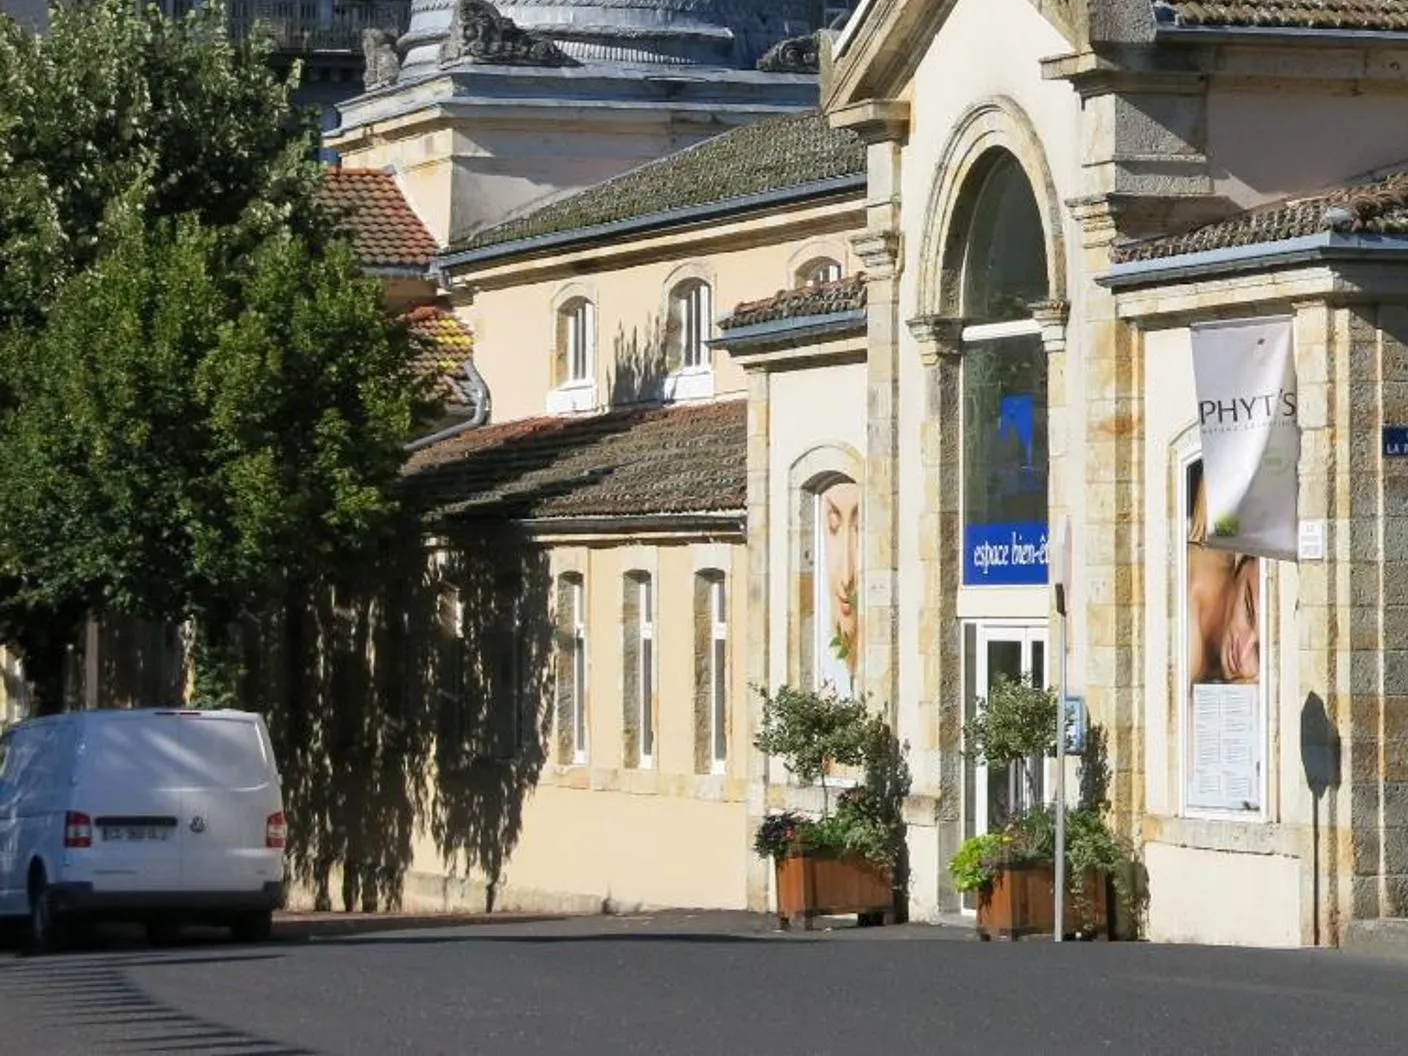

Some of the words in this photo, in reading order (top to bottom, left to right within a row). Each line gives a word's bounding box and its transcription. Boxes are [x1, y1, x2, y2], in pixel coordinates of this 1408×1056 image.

[1199, 388, 1297, 425] PHYT'S
[1386, 443, 1400, 454] LA
[973, 540, 1009, 575] espace
